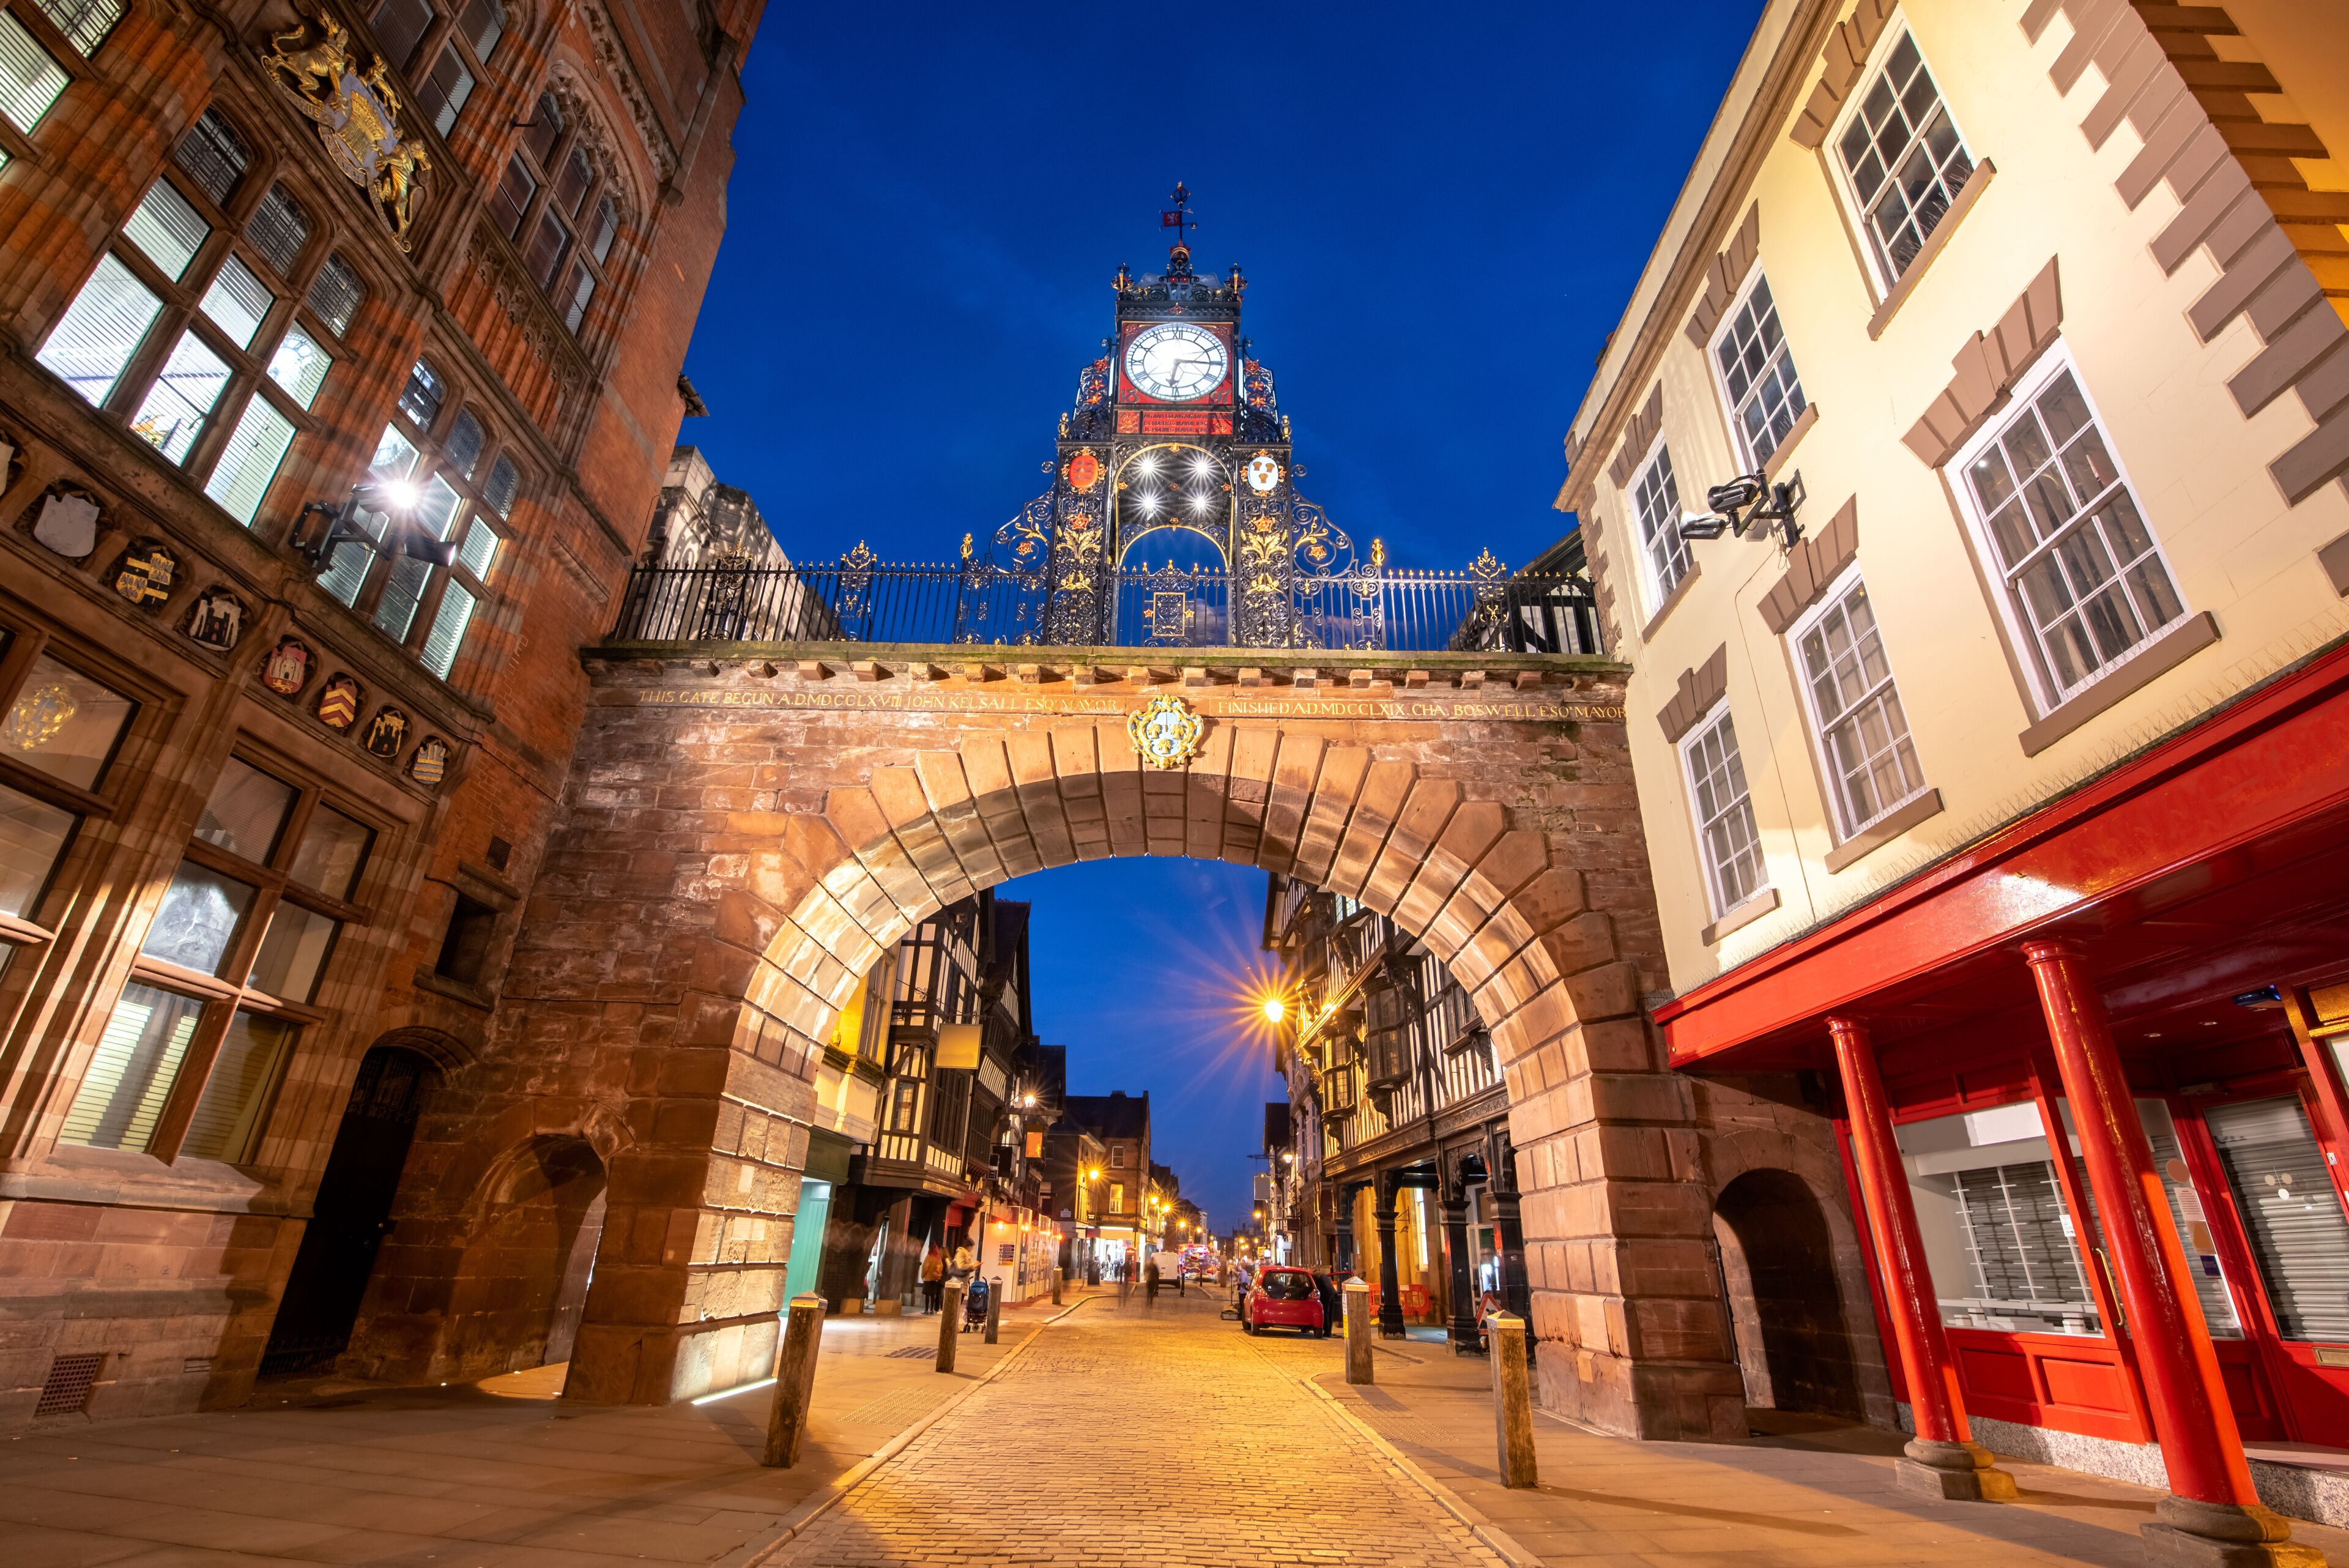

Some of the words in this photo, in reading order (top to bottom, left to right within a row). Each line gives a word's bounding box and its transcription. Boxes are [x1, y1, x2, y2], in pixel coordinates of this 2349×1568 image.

[1119, 388, 1140, 404] 18
[1210, 388, 1232, 404] 97
[640, 691, 676, 703] THIS
[680, 691, 719, 704] GATE
[724, 693, 774, 705] BEGUN
[905, 696, 944, 710] JOHN
[949, 696, 1020, 710] KELSALL
[1061, 699, 1117, 712] MAYOR
[1218, 701, 1290, 714] FINISHED
[1412, 704, 1450, 716] CHA.
[1453, 704, 1535, 718] BOSWELL
[1574, 706, 1627, 718] MAYOR
